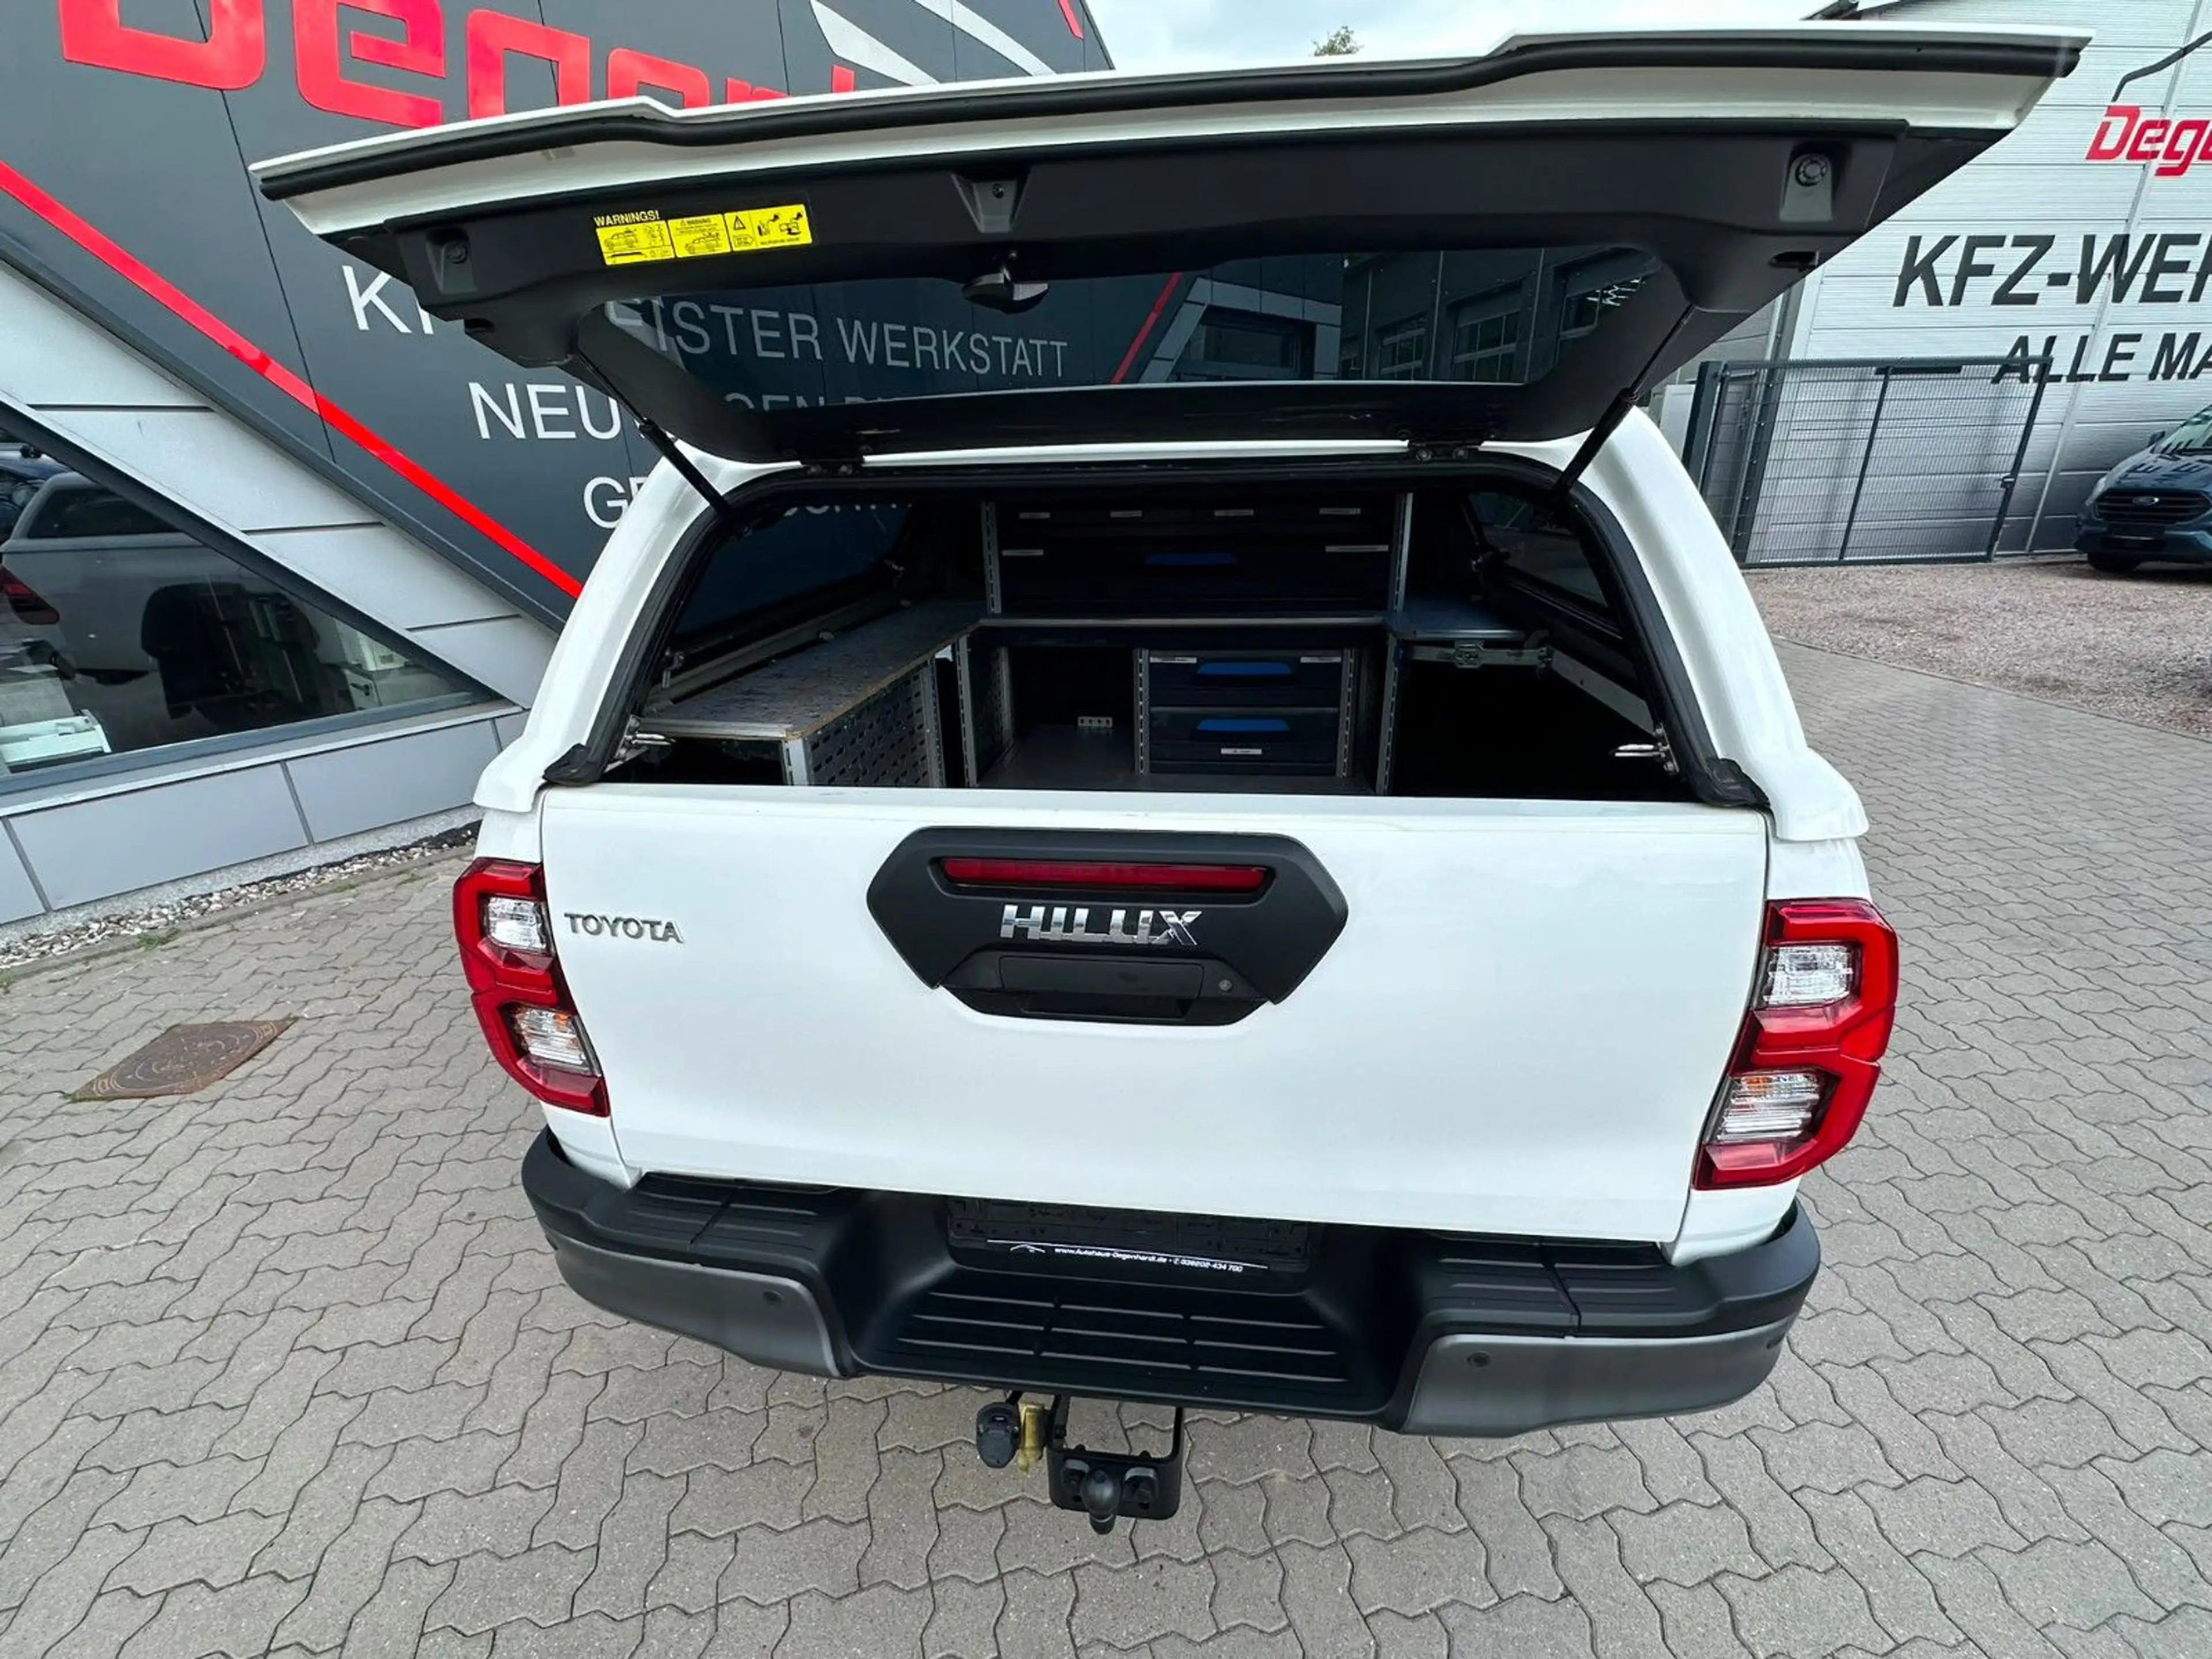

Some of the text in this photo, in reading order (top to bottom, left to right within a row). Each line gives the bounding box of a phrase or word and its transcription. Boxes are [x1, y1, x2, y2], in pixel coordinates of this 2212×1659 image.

[593, 209, 660, 227] WARNINGS!
[836, 317, 1068, 377] WERKSTATT
[1990, 332, 2143, 384] ALLE
[563, 912, 684, 944] TOYOTA
[1000, 904, 1202, 945] HILUX
